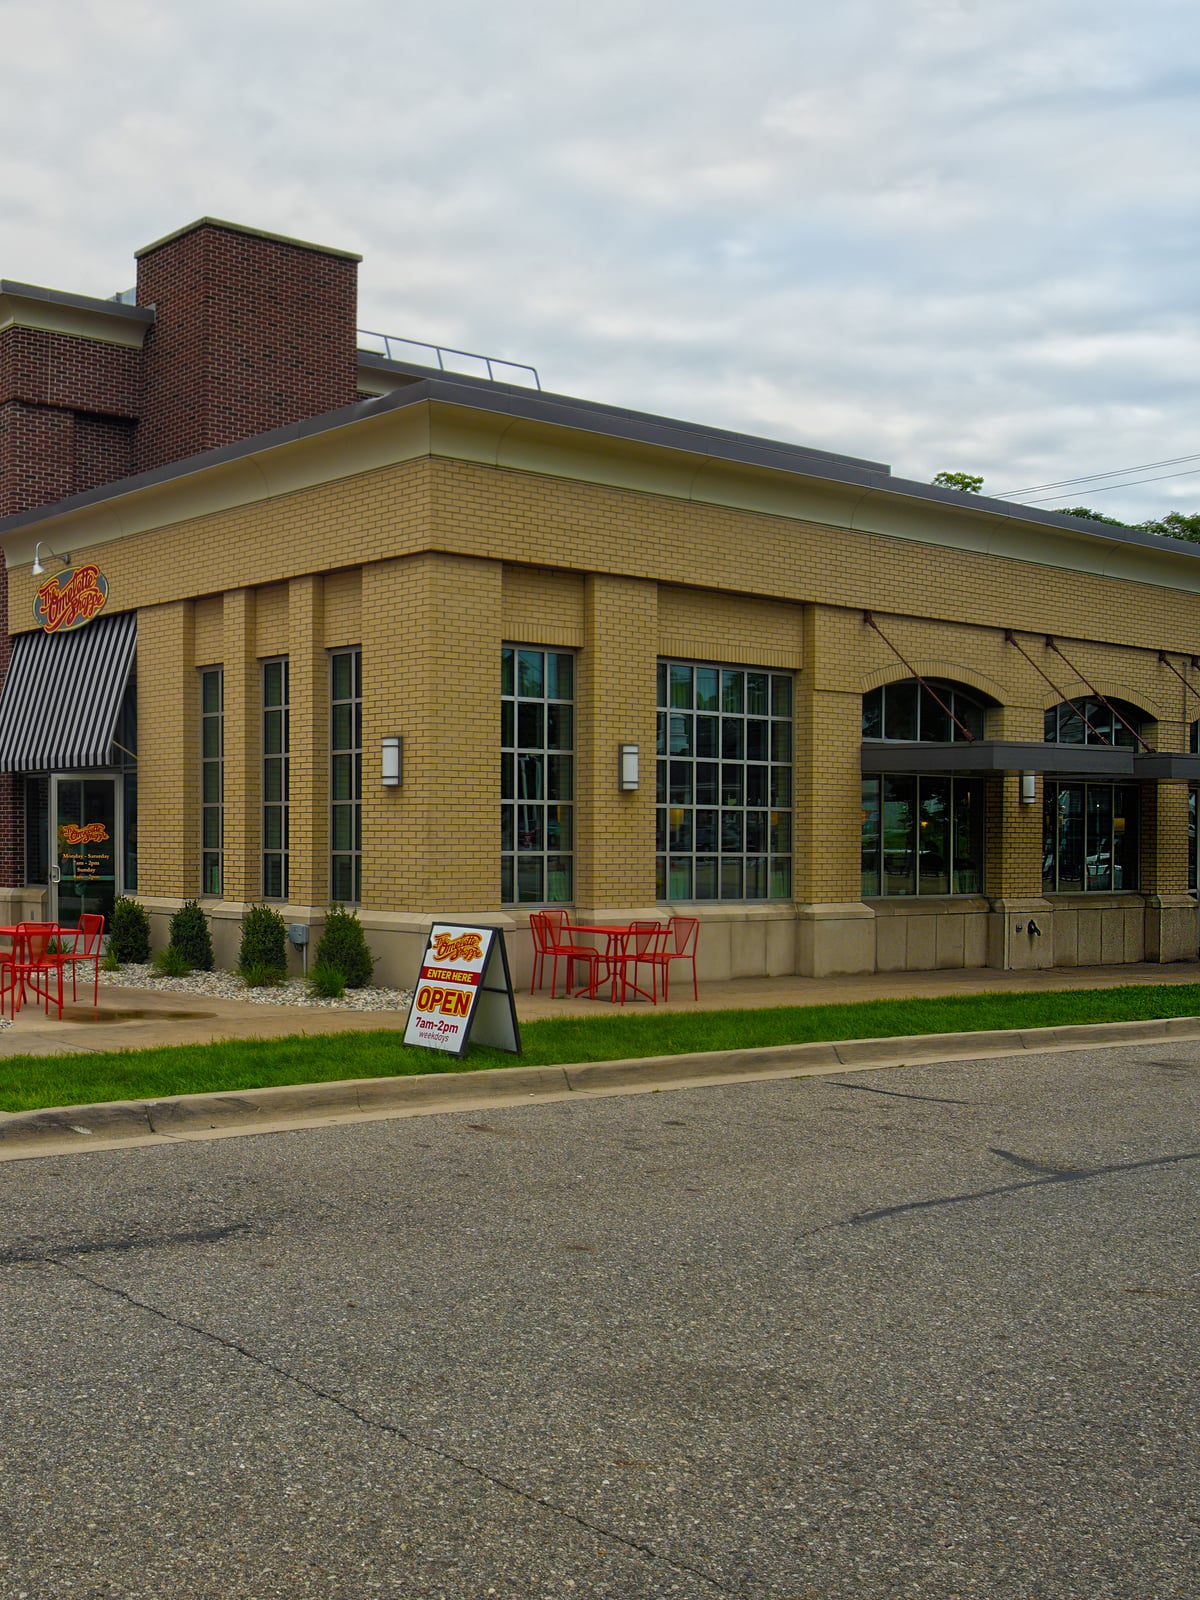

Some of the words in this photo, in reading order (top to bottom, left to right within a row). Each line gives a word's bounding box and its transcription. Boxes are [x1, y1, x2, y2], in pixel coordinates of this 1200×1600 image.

[39, 579, 59, 614] The
[44, 565, 99, 633] Omelette
[66, 588, 104, 626] Shoppe
[433, 933, 483, 962] Omelette
[449, 945, 483, 962] Shoppe
[427, 969, 452, 980] ENTER
[452, 972, 473, 983] HERE
[416, 986, 473, 1018] OPEN
[415, 1016, 459, 1034] 7am-2pm
[419, 1031, 449, 1043] weekdays
